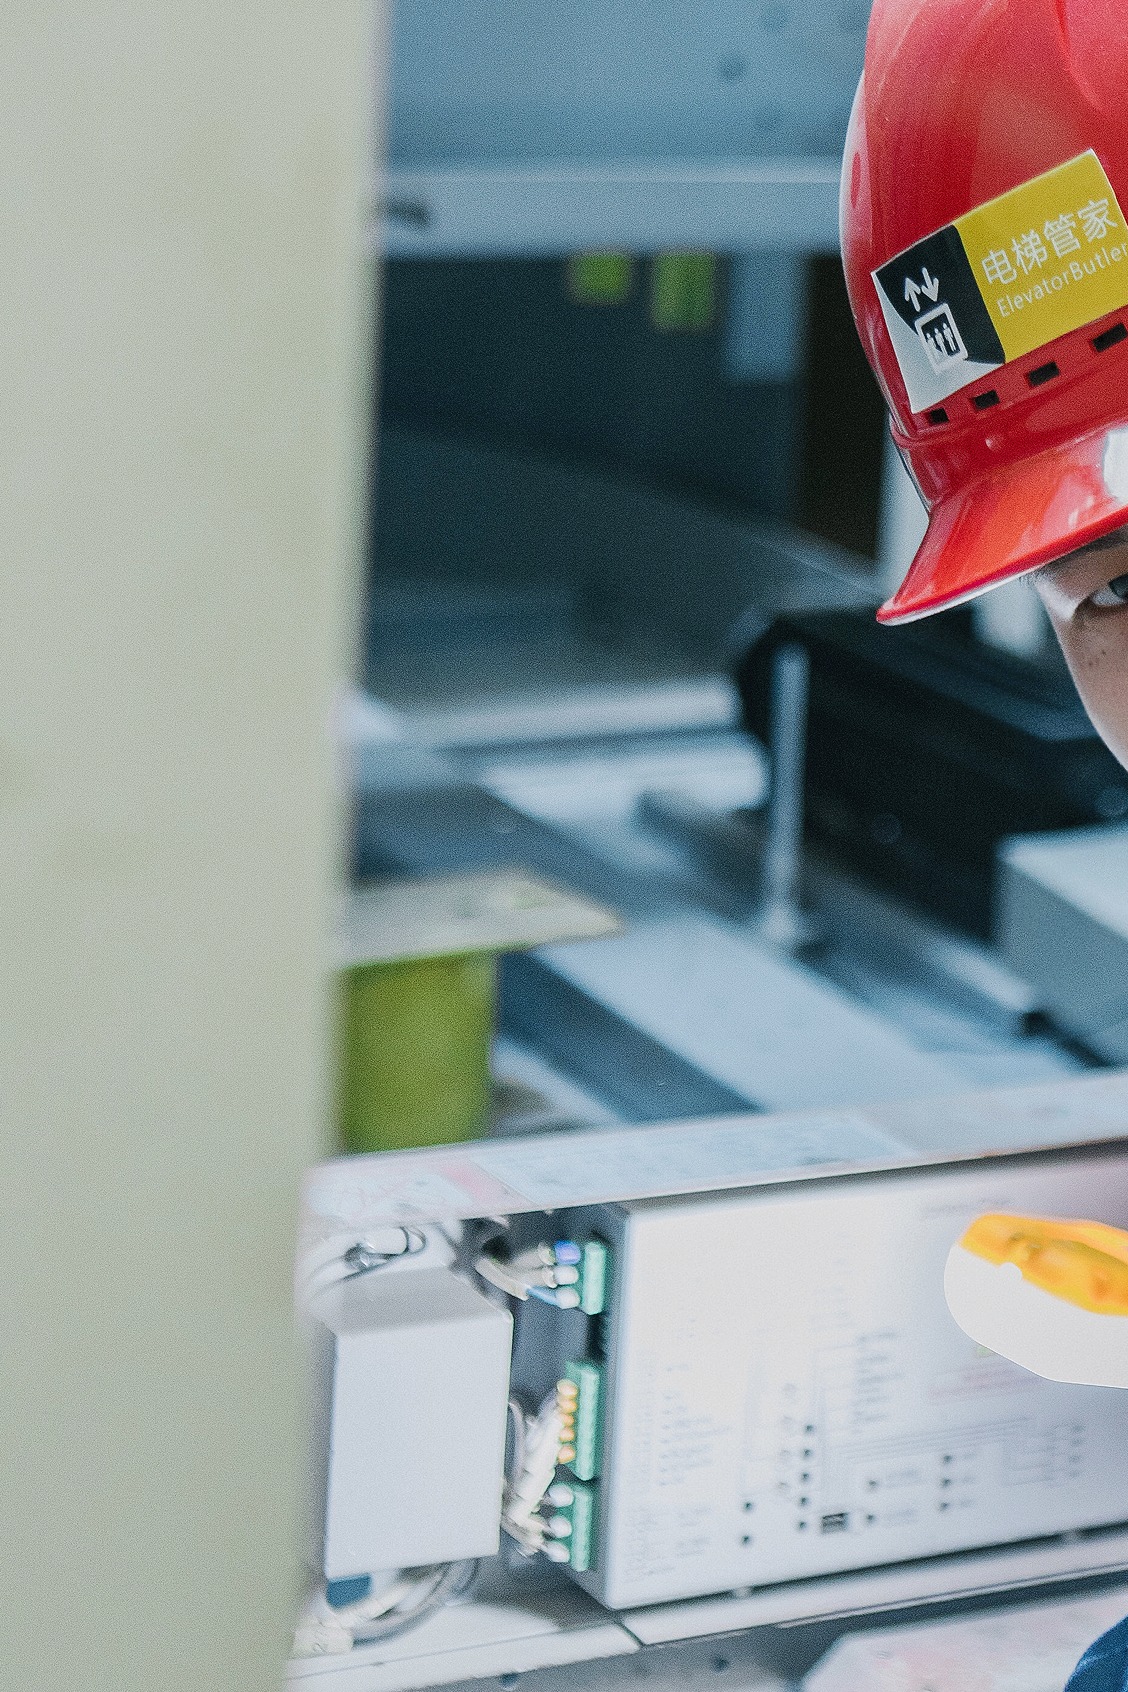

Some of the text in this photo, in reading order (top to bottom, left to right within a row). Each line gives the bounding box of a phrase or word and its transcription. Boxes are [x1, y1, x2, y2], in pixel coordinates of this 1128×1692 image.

[981, 198, 1118, 286] 电梯管家
[996, 242, 1128, 317] ElevatorButler
